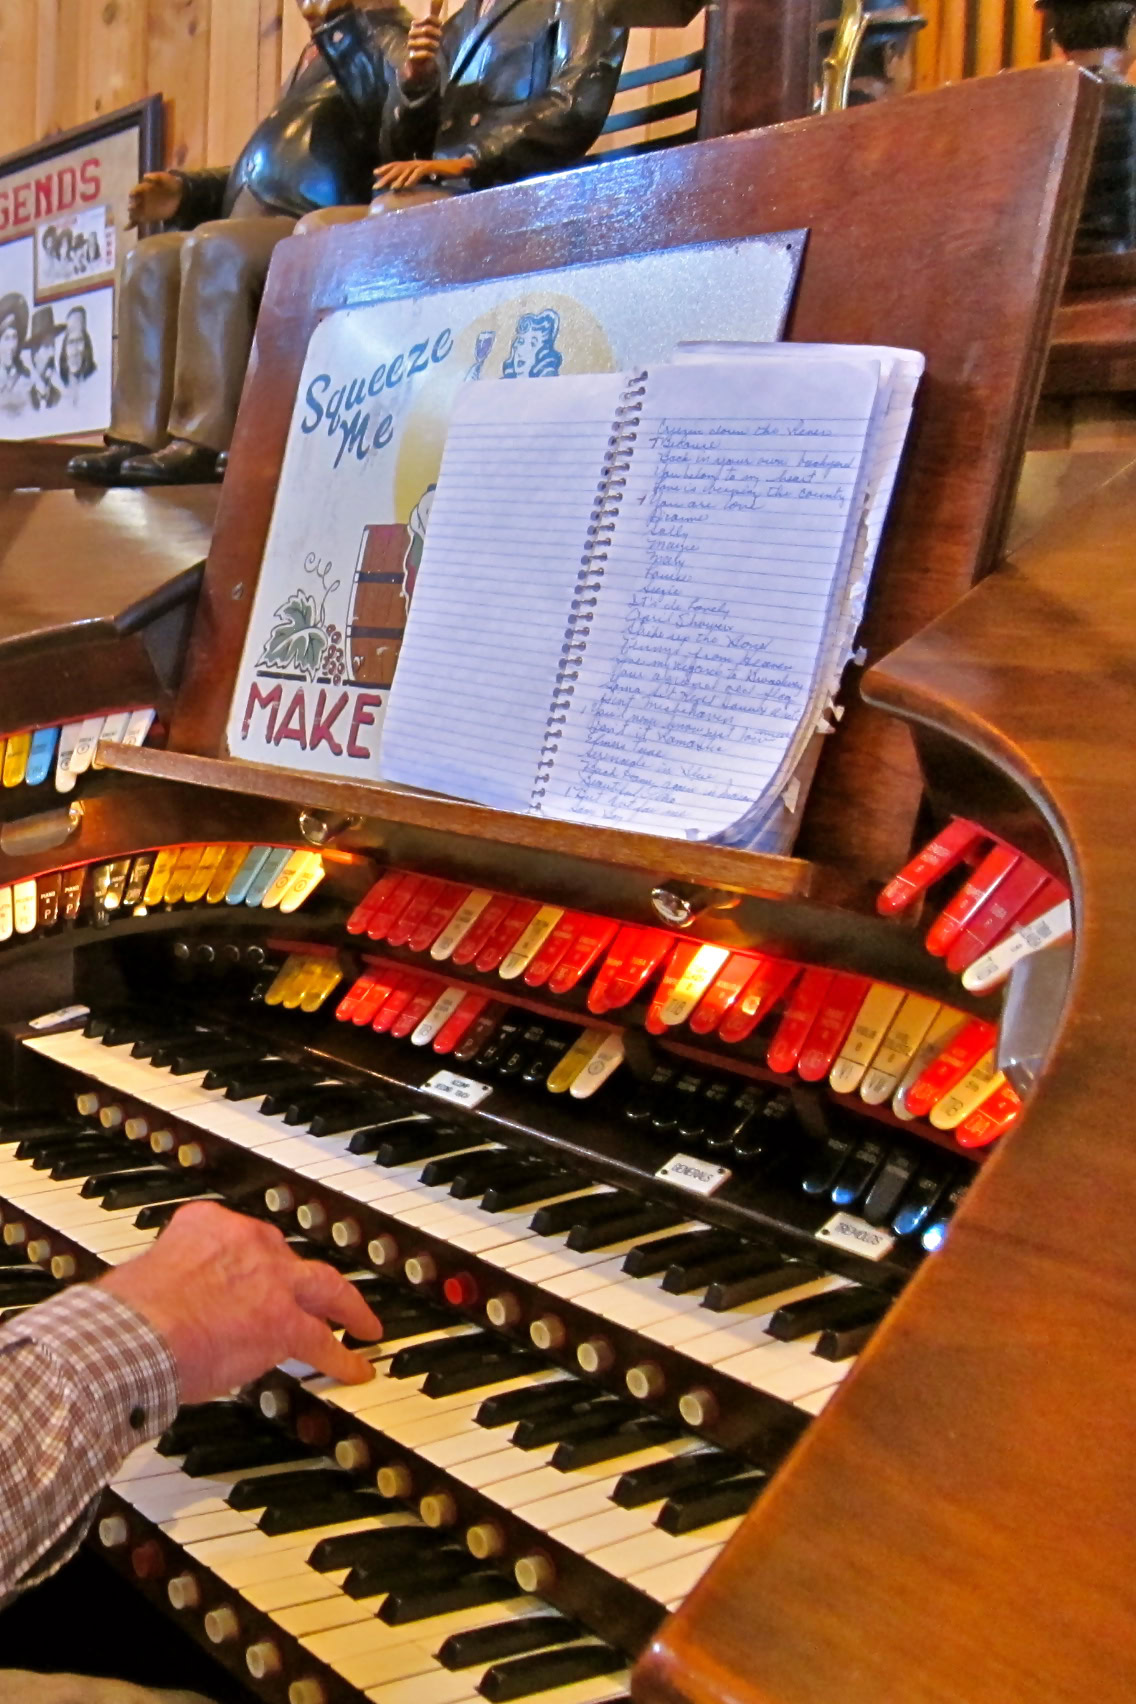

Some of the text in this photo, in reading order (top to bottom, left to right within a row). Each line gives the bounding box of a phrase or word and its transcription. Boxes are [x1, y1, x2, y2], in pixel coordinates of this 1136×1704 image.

[300, 326, 454, 434] Squeeze
[752, 423, 779, 437] the
[335, 412, 395, 472] Me
[696, 456, 711, 464] in
[723, 468, 739, 481] to
[766, 469, 817, 483] heart
[685, 486, 699, 494] is
[766, 484, 792, 498] the
[687, 501, 717, 509] are
[625, 607, 673, 626] April
[240, 684, 382, 759] MAKE
[671, 1162, 714, 1183] GENERALS
